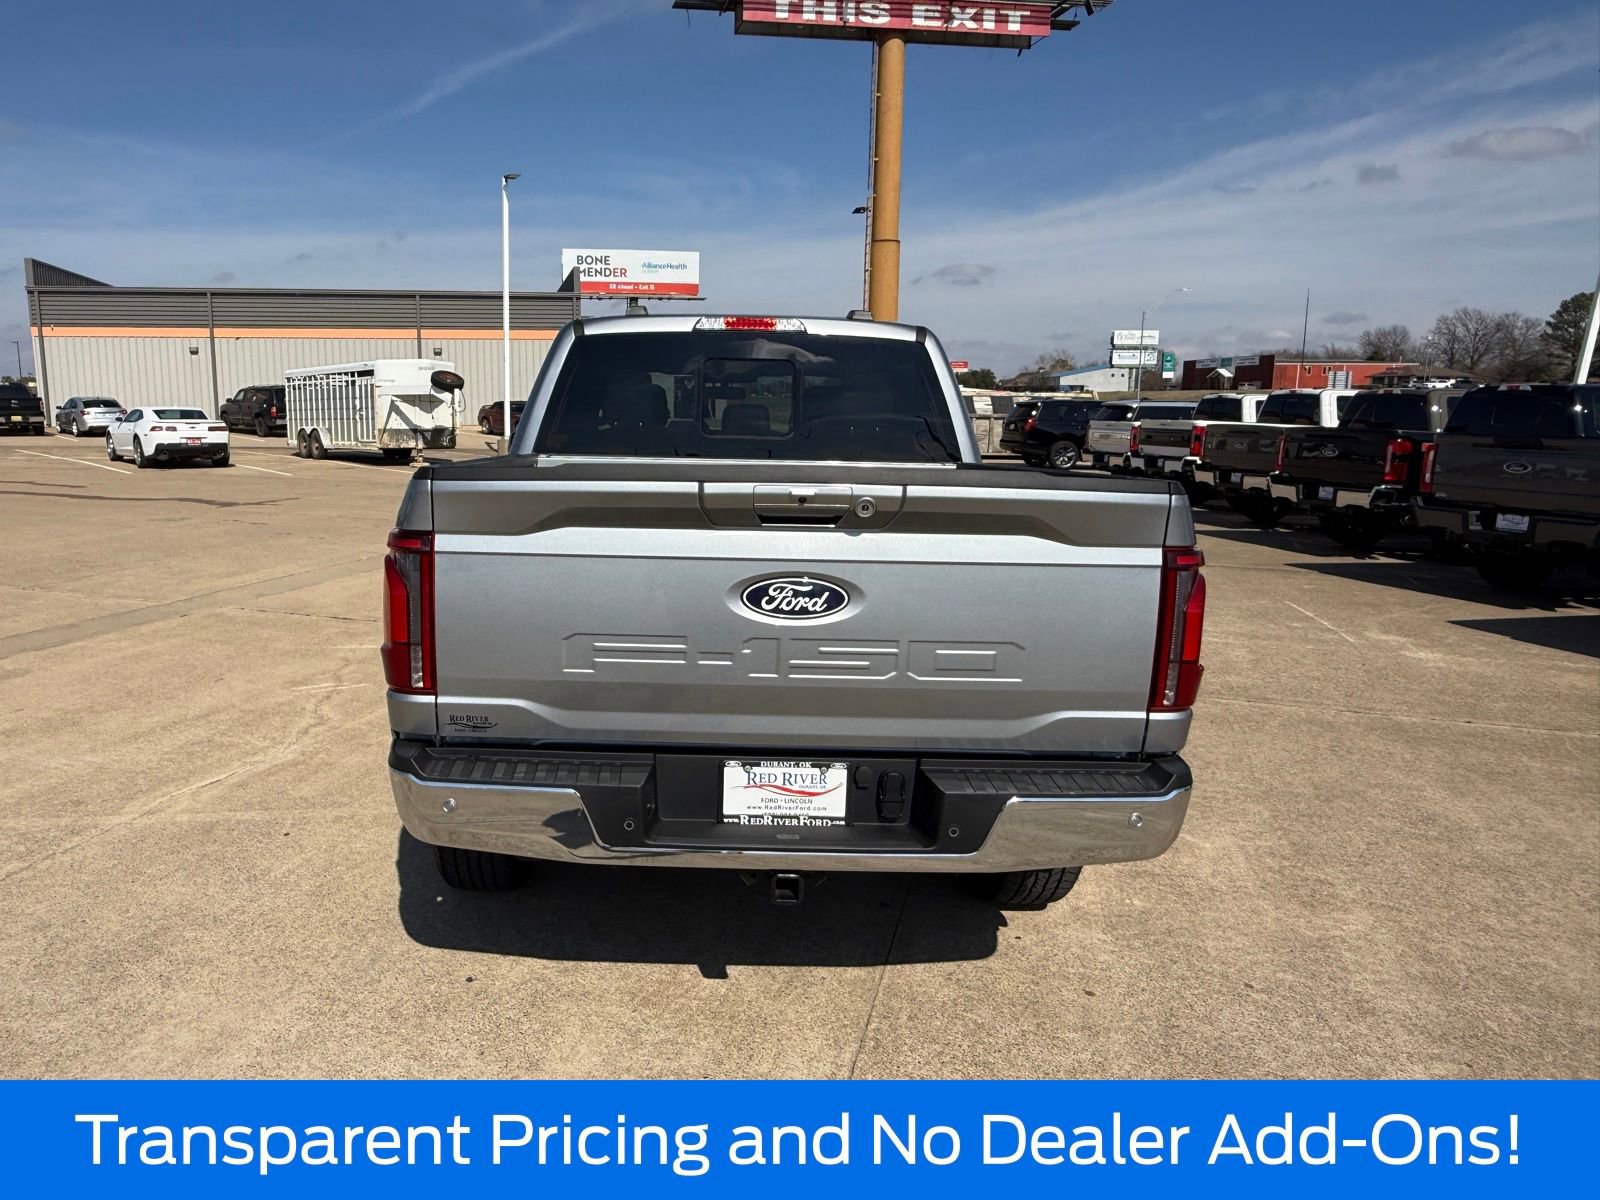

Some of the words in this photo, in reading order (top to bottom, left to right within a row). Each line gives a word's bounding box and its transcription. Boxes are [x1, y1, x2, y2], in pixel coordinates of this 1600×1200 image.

[774, 0, 891, 24] THIS
[911, 3, 1031, 32] EXIT
[576, 255, 611, 266] BONE
[579, 267, 628, 278] MENDER
[760, 583, 829, 614] Ford
[562, 633, 1026, 682] F-150
[449, 714, 465, 723] RED
[466, 714, 489, 723] RIVER
[746, 771, 778, 785] RED
[782, 772, 828, 787] RIVER
